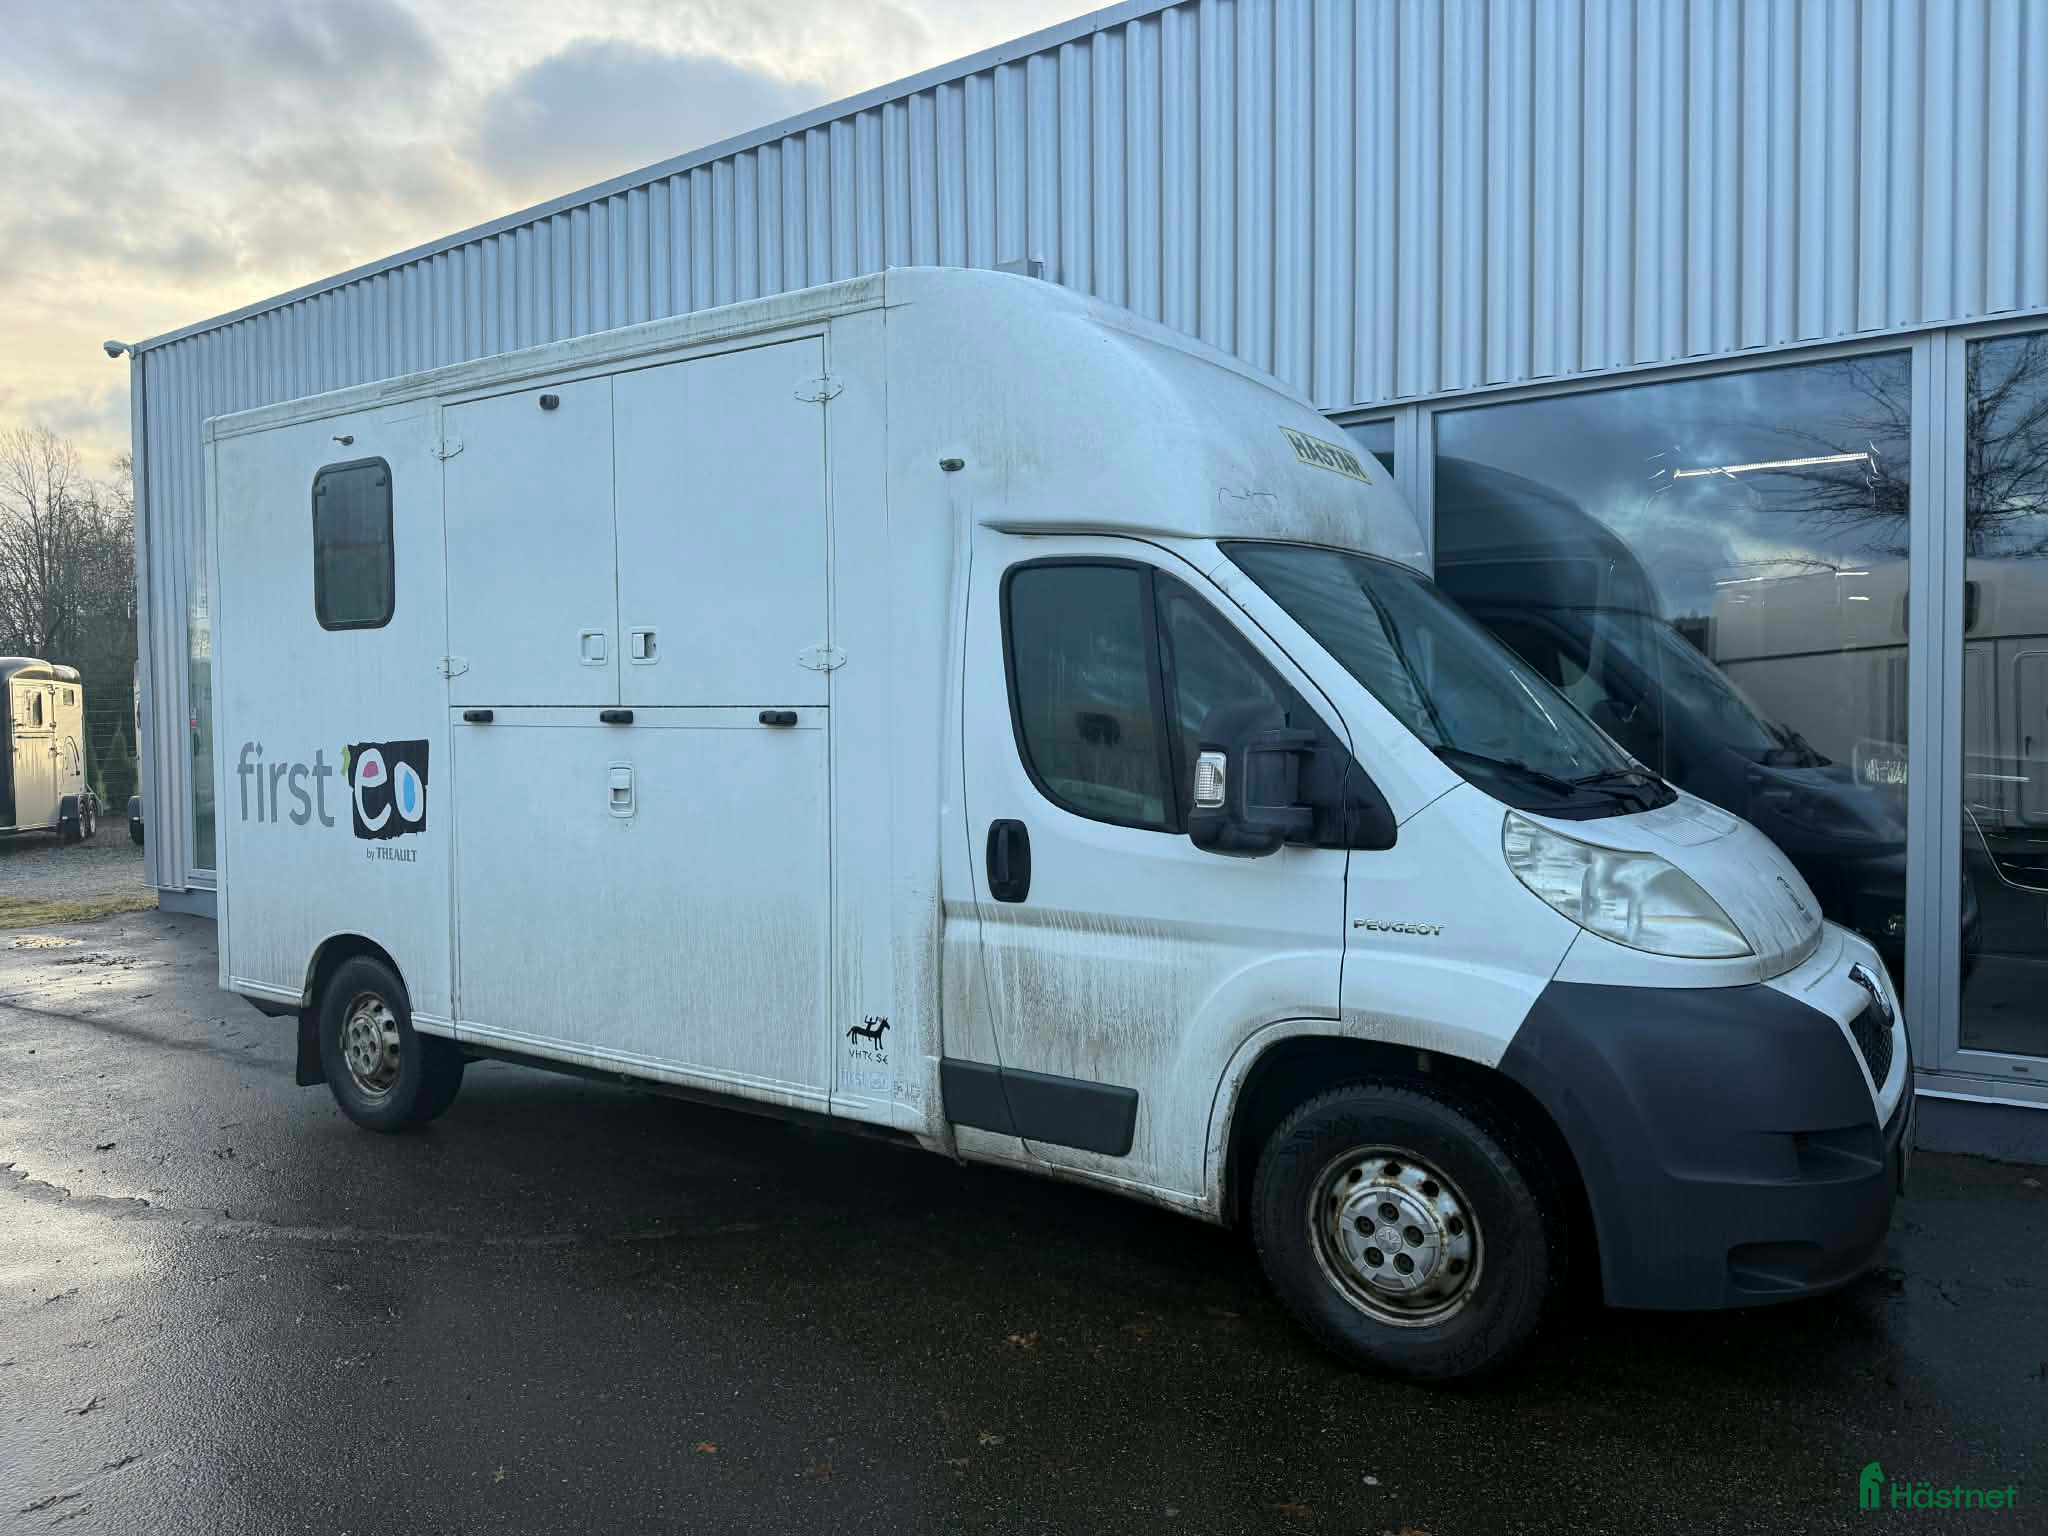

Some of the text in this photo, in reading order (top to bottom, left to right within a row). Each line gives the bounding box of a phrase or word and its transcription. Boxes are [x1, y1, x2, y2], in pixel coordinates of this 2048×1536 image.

[237, 741, 334, 827] first
[366, 847, 416, 862] by THEAULT
[1353, 919, 1444, 936] PEUGEOT
